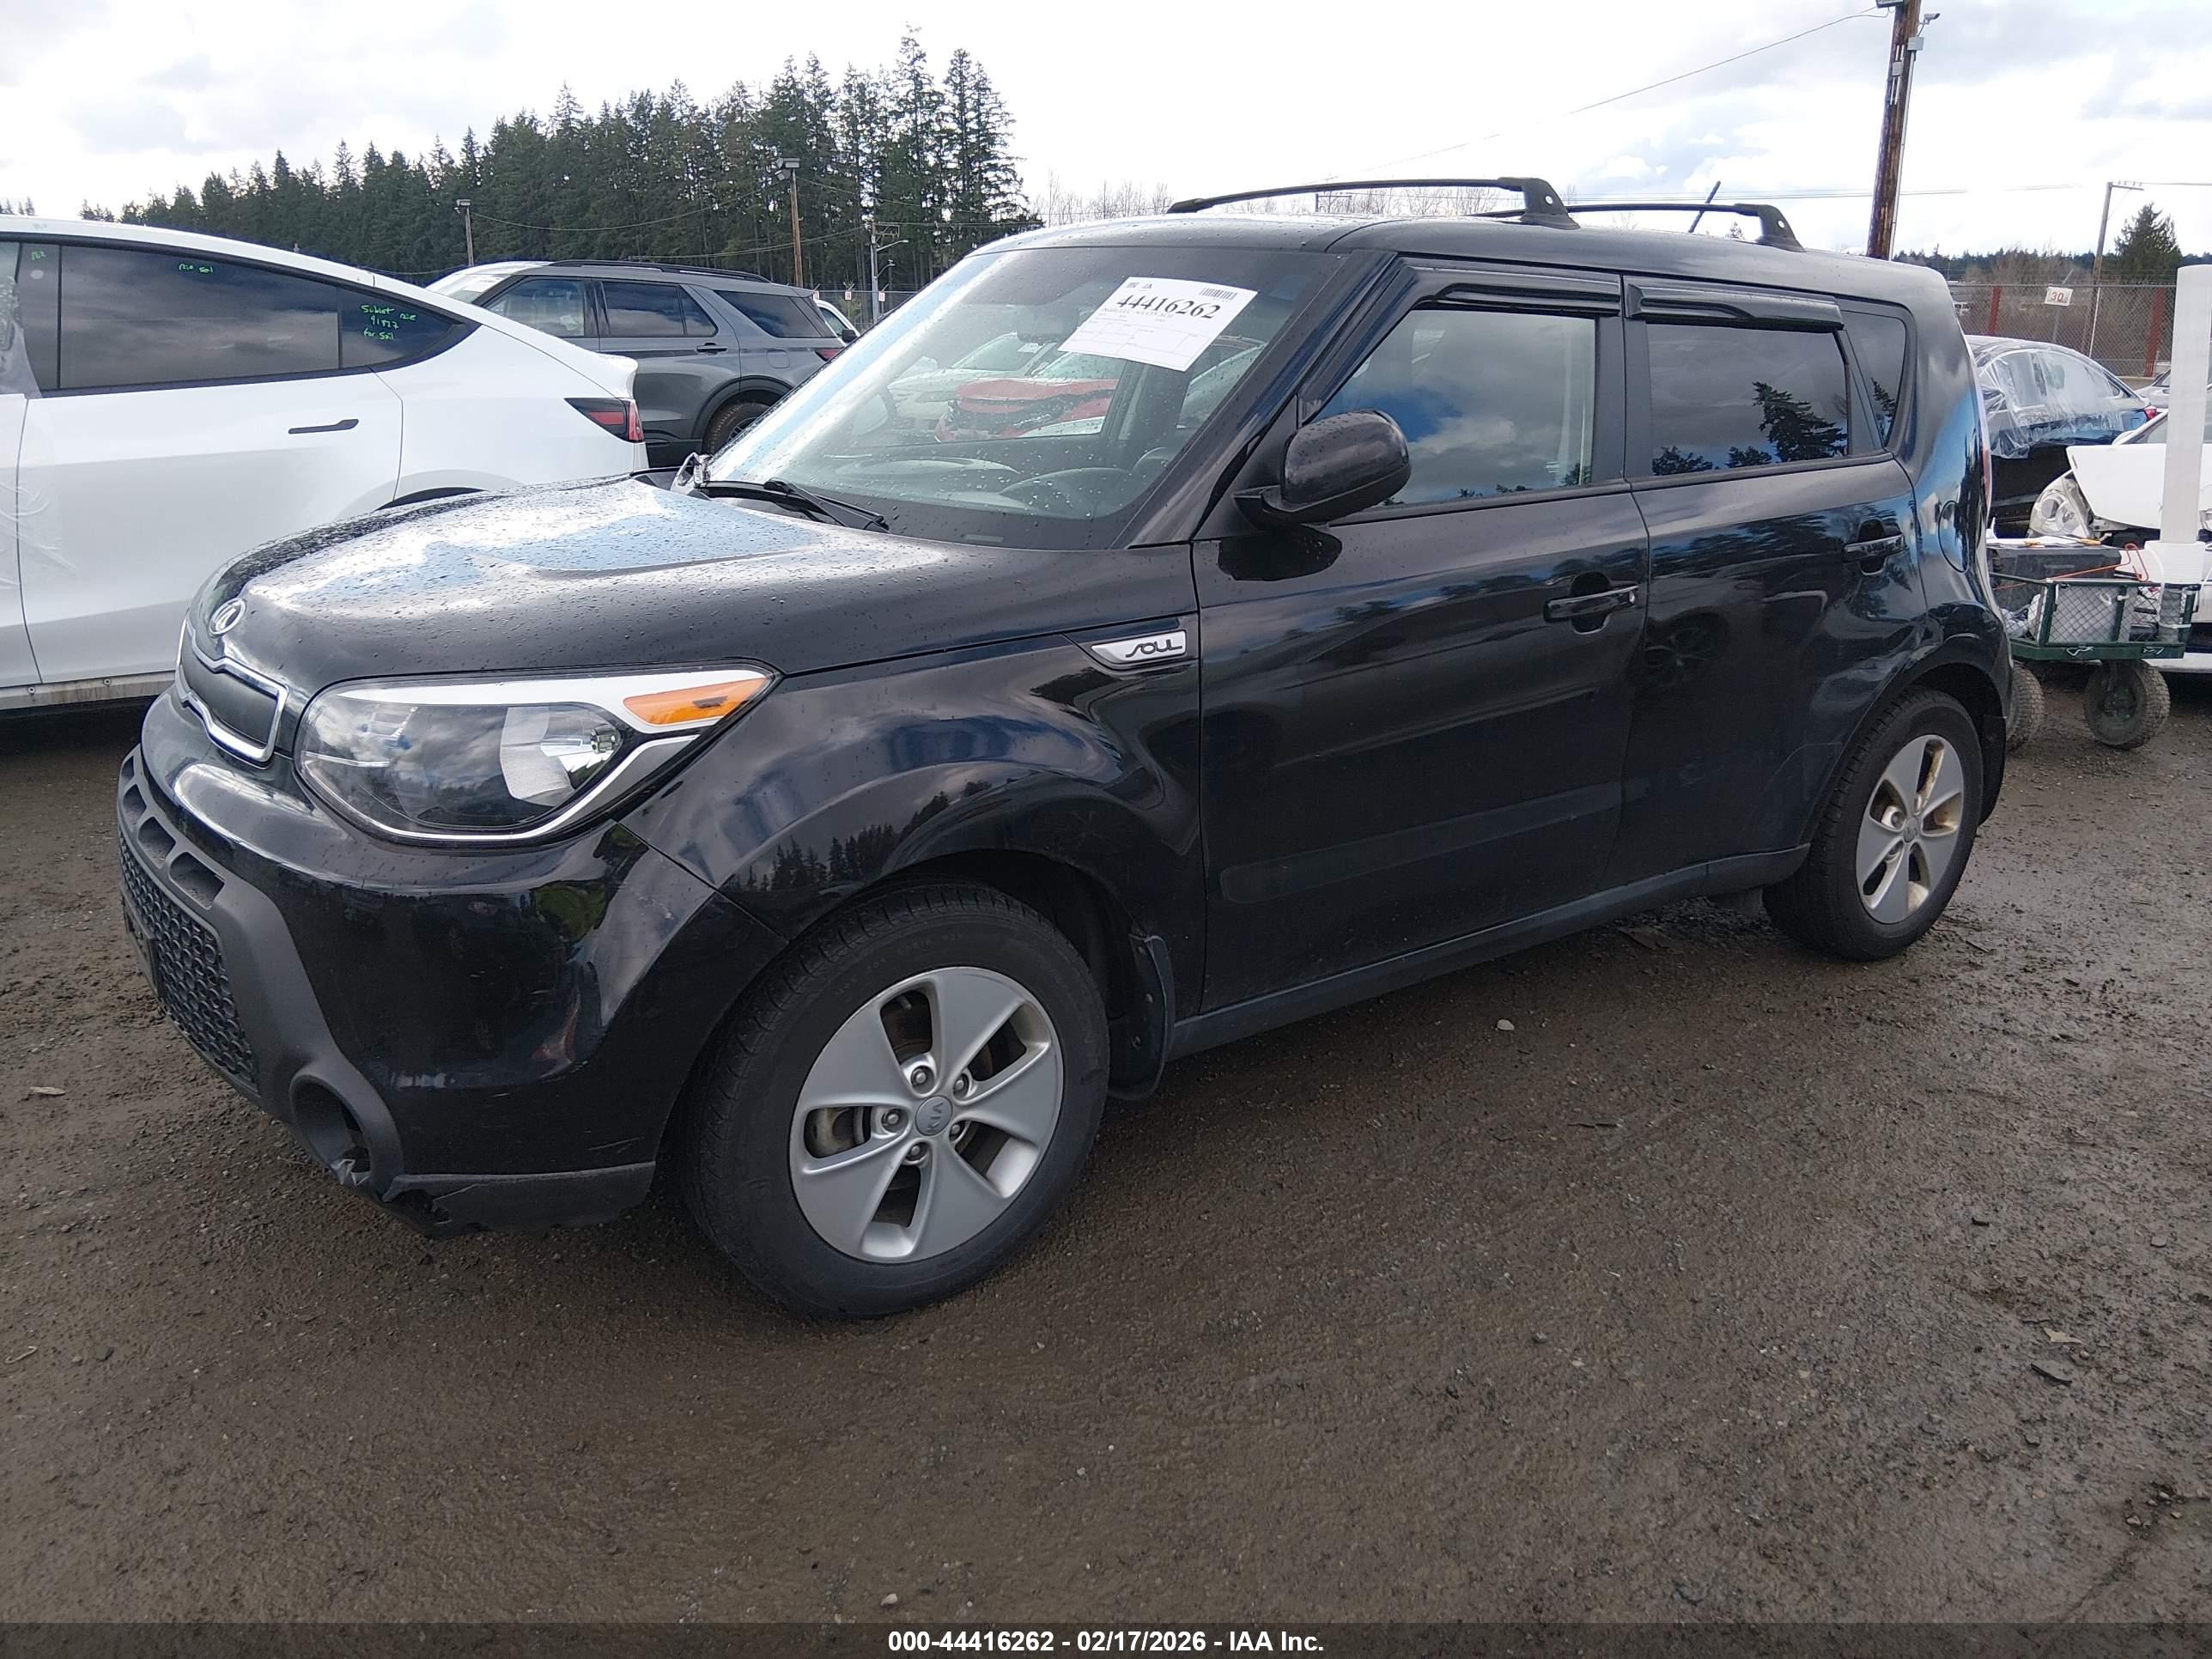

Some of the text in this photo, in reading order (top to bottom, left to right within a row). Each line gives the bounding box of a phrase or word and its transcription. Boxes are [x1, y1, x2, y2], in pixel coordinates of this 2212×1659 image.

[2052, 292, 2063, 301] 30
[1116, 295, 1220, 319] 44416262
[1125, 639, 1183, 658] SOUL
